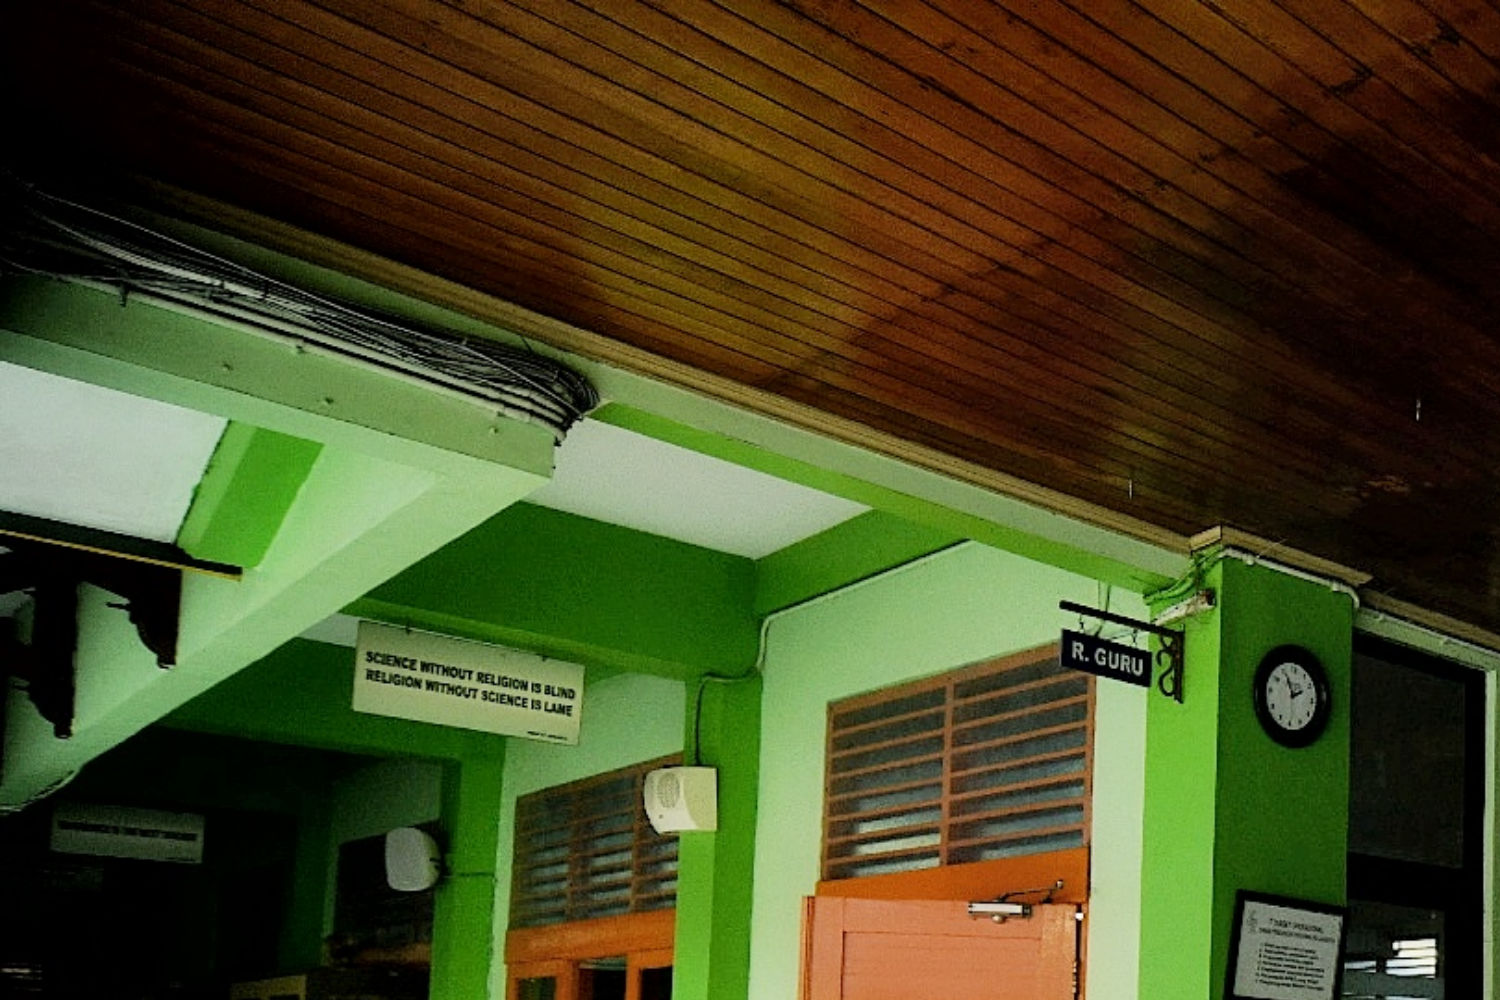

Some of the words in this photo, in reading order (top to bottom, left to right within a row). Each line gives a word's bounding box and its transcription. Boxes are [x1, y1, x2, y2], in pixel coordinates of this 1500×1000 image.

[366, 651, 417, 672] SCIENCE
[420, 660, 474, 682] WITHOUT
[476, 671, 529, 693] RELIGION
[531, 682, 542, 694] IS
[544, 684, 576, 700] BLIND
[1071, 640, 1089, 662] R.
[1094, 647, 1144, 677] GURU
[365, 668, 422, 690] RELIGION
[425, 679, 480, 700] WITHOUT
[481, 690, 529, 709] SCIENCE
[531, 699, 542, 711] IS
[544, 701, 573, 717] LAME
